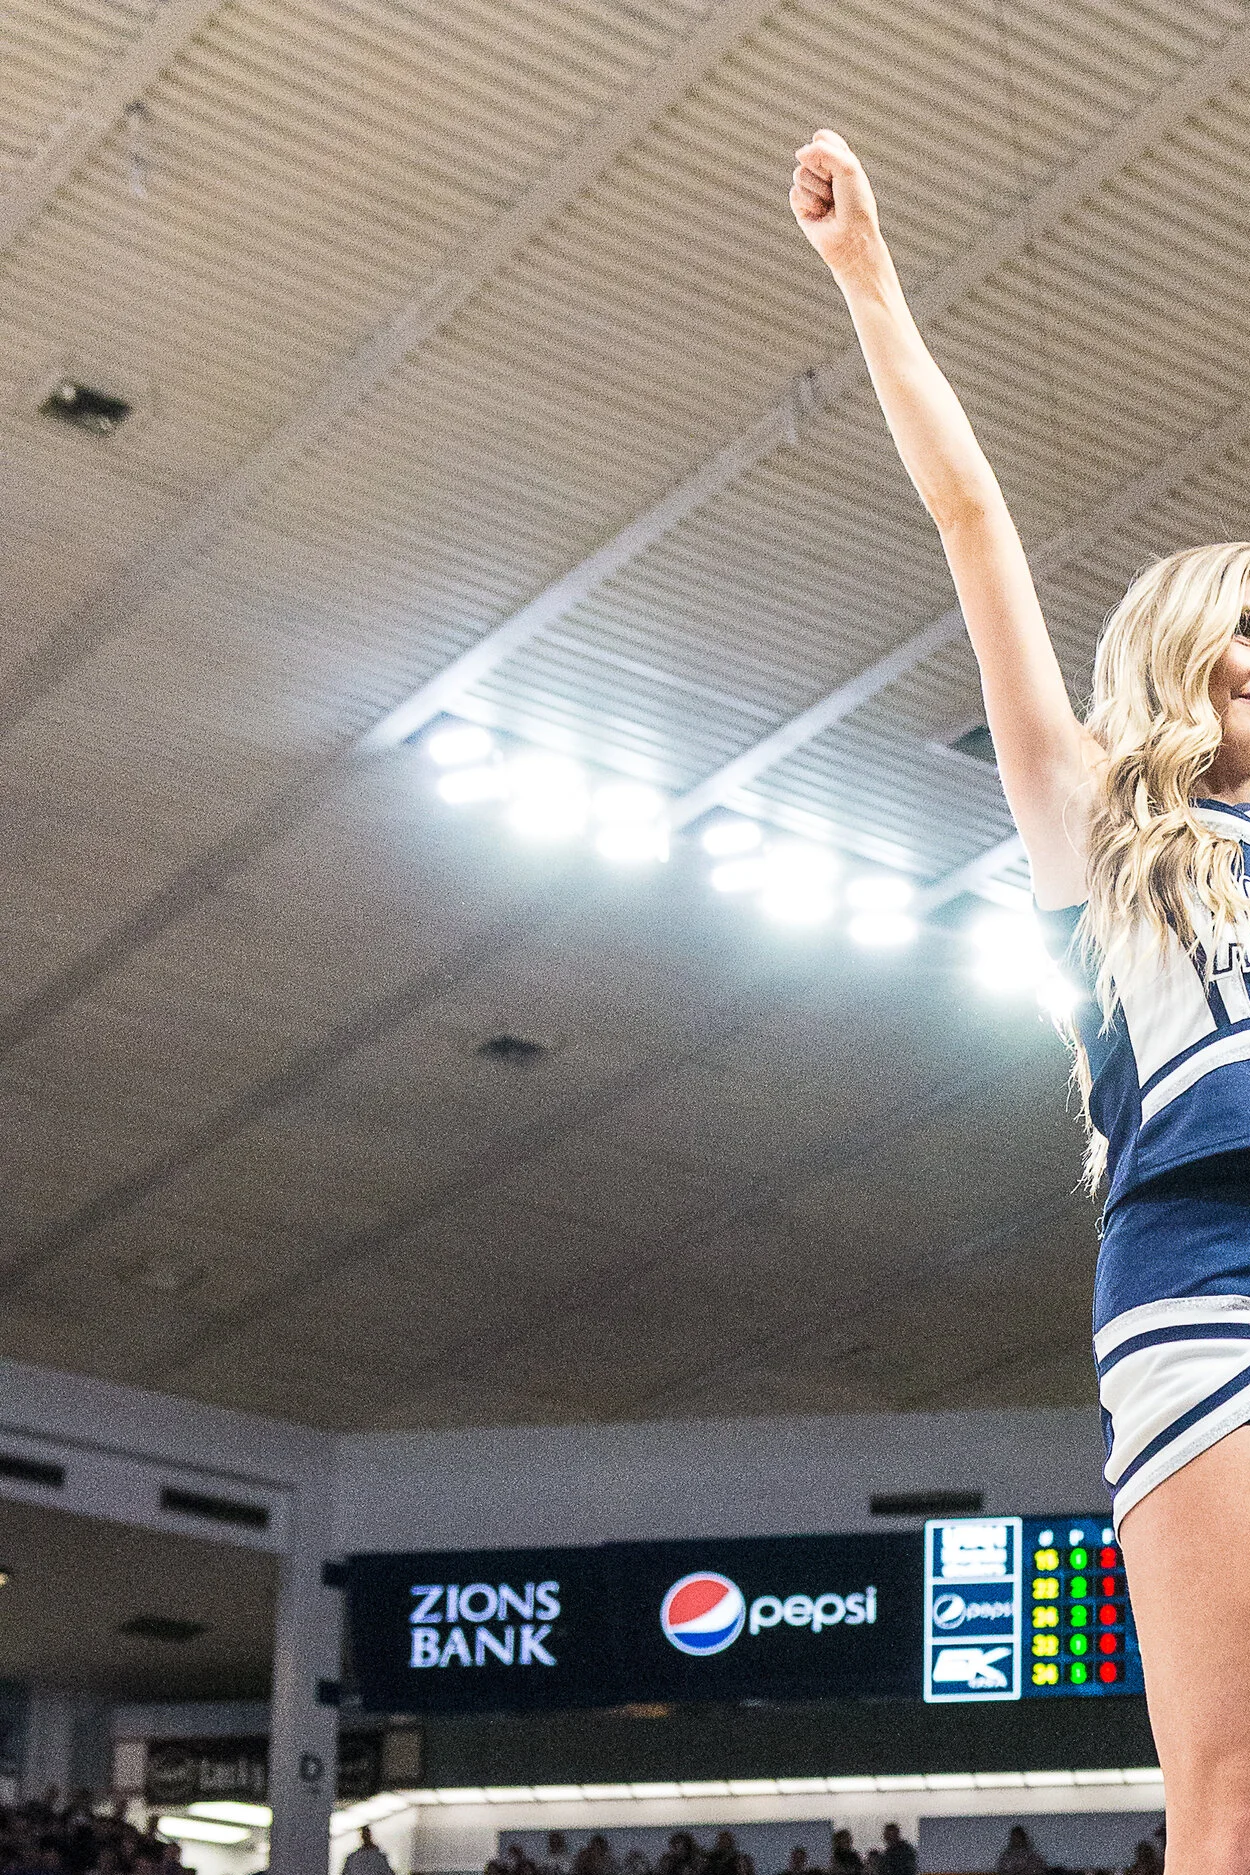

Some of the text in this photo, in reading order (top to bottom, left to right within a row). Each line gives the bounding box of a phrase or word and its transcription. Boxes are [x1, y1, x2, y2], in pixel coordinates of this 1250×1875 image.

[410, 1580, 561, 1624] ZIONS
[749, 1584, 877, 1637] pepsi
[410, 1623, 558, 1669] BANK
